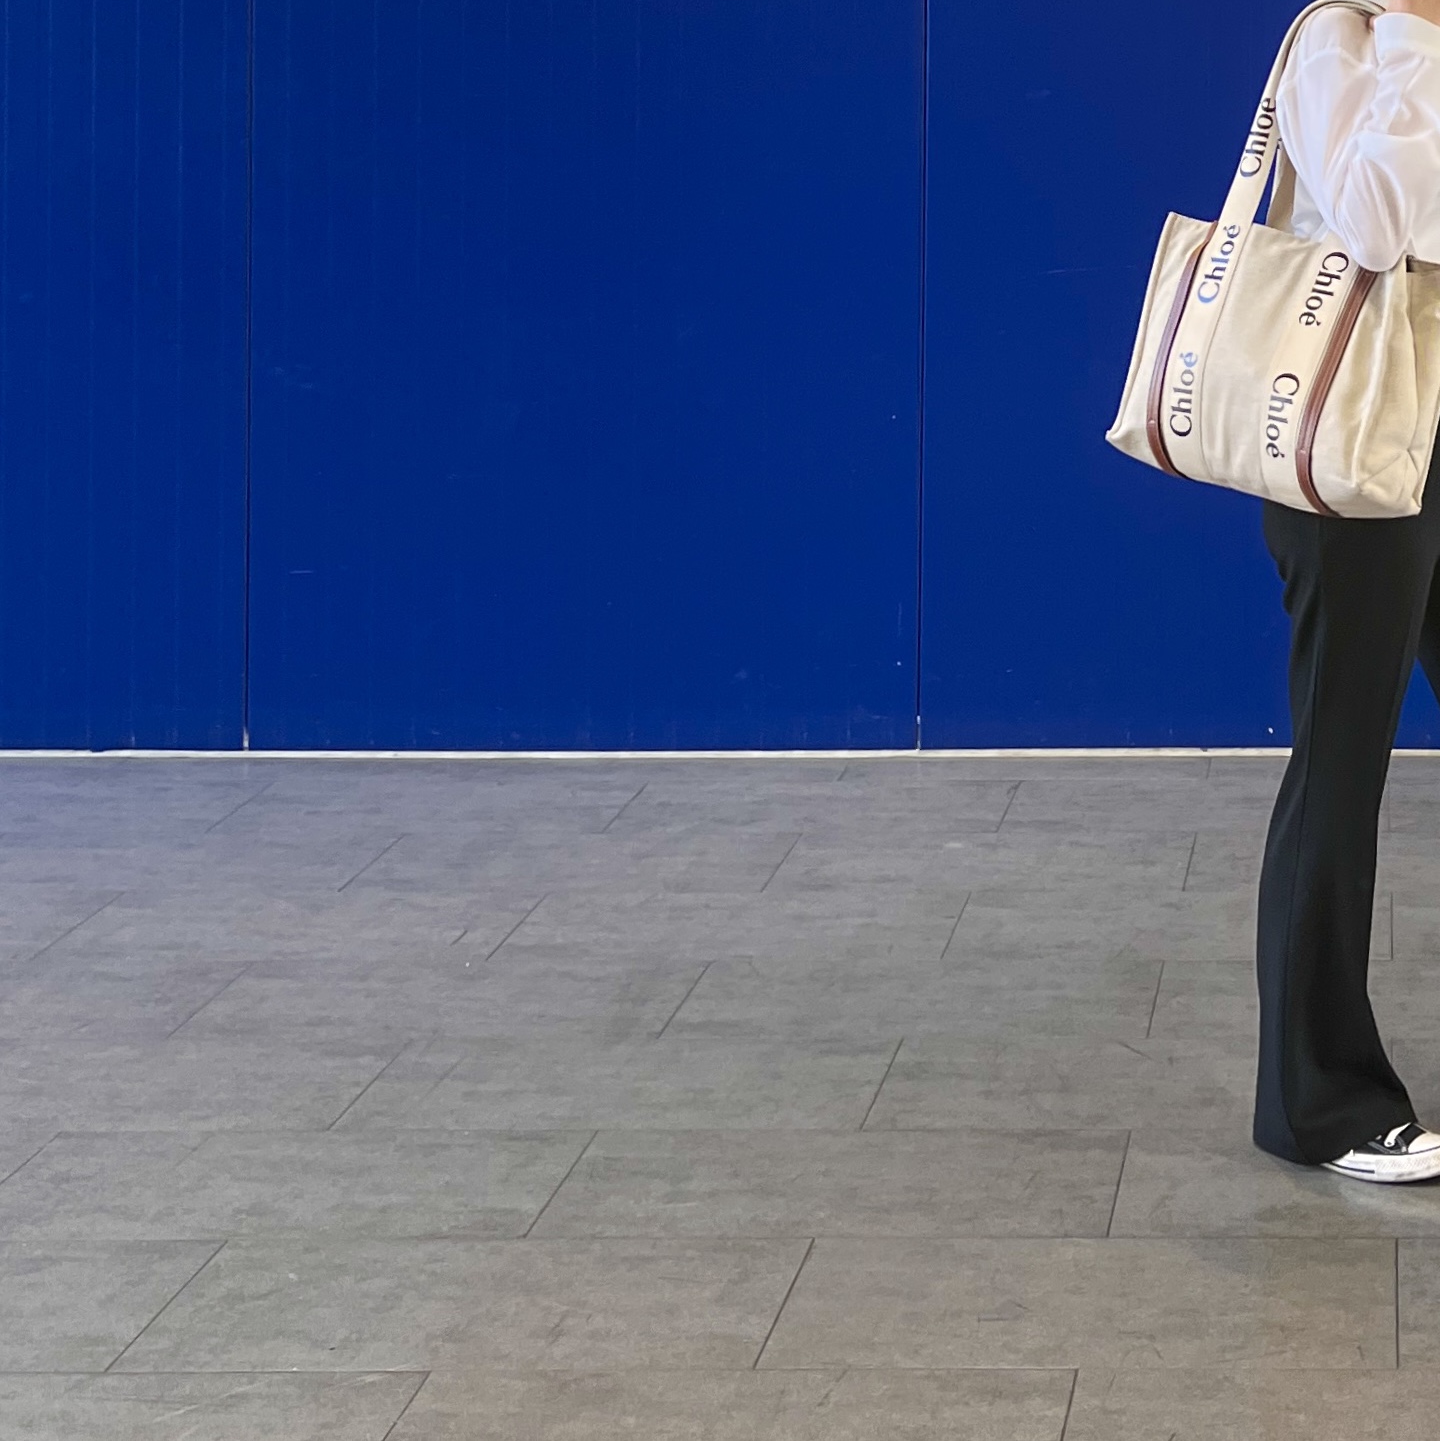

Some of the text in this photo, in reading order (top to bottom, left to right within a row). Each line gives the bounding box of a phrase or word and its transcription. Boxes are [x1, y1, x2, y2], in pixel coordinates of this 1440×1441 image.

[1197, 224, 1240, 303] Chloé
[1299, 251, 1349, 327] Chloé
[1169, 352, 1198, 437] Chloé
[1265, 372, 1300, 458] Chloé
